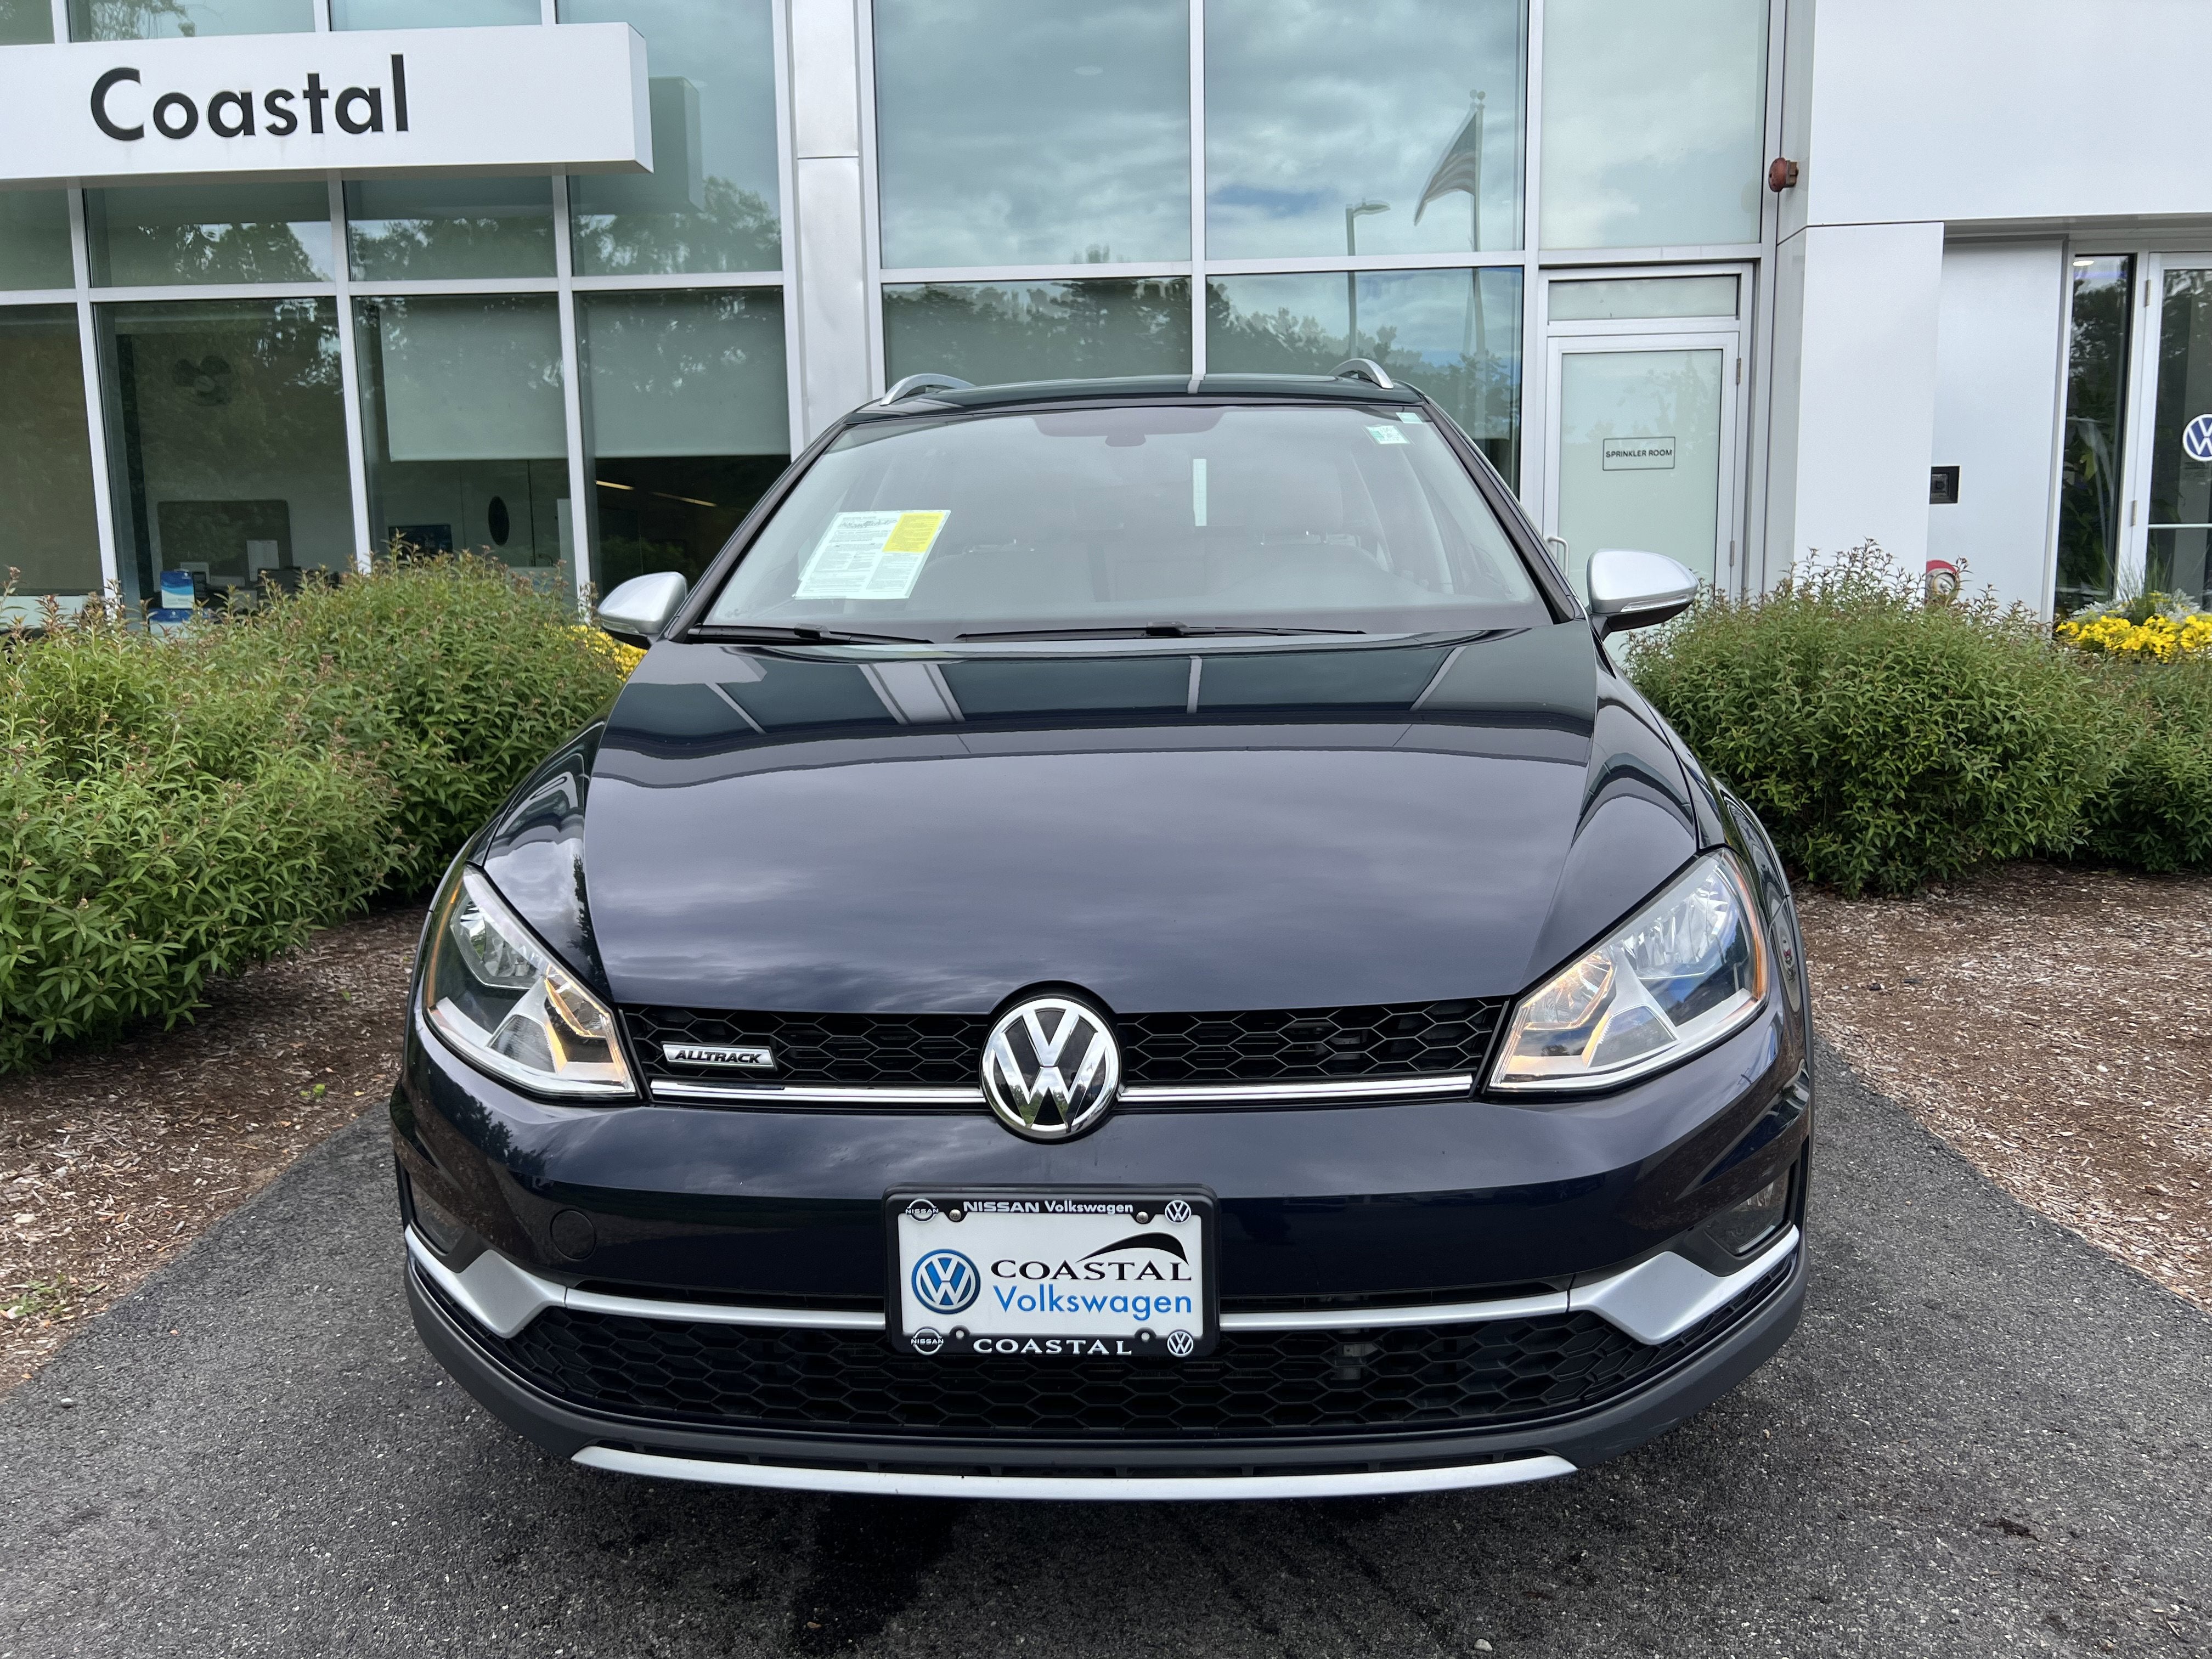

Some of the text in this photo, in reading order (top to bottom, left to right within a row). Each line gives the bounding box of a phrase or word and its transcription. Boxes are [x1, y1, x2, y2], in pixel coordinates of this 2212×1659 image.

[91, 53, 410, 141] Coastal
[675, 1050, 762, 1063] ALLTRACK
[983, 998, 1119, 1138] VW
[963, 1199, 1133, 1215] NISSAN Volkswagen
[1165, 1200, 1192, 1223] VW
[911, 1249, 980, 1314] VW
[991, 1260, 1192, 1281] COASTAL
[993, 1284, 1192, 1321] Volkswagen
[973, 1338, 1132, 1355] COASTAL
[1167, 1330, 1194, 1357] VW
